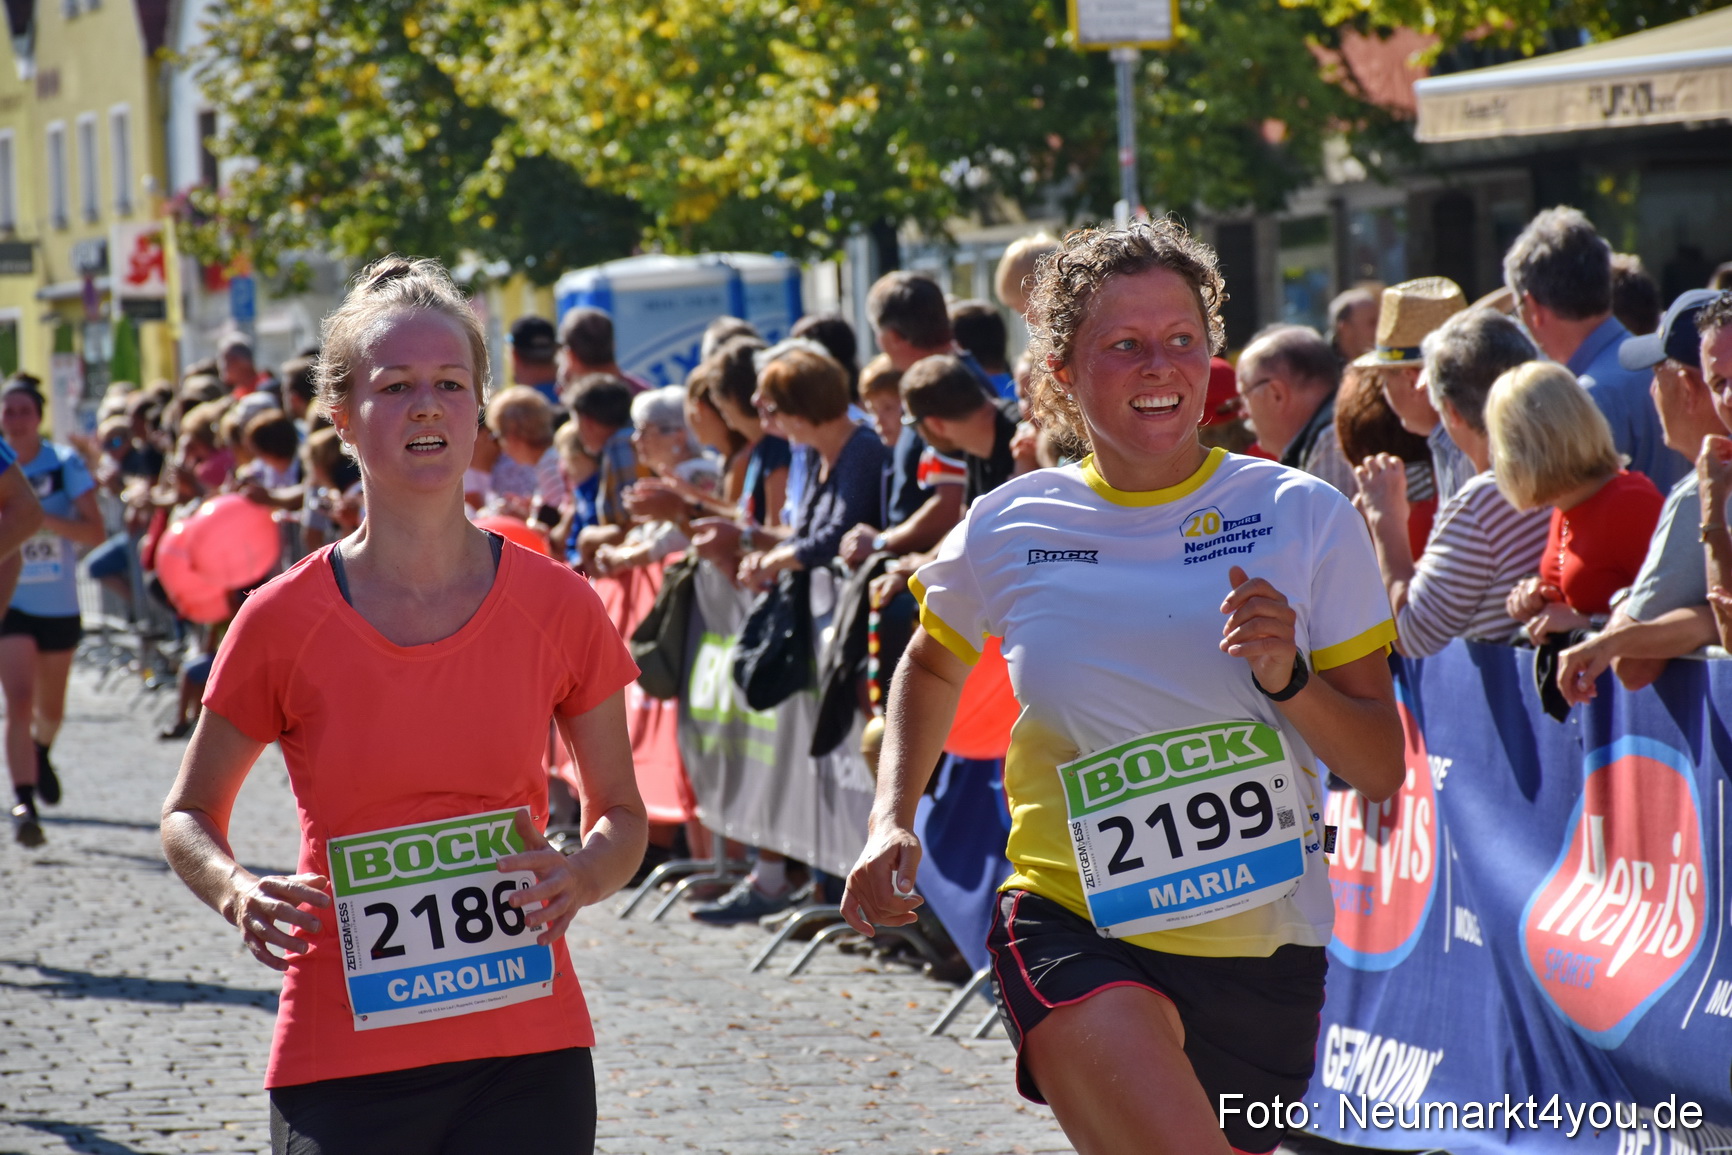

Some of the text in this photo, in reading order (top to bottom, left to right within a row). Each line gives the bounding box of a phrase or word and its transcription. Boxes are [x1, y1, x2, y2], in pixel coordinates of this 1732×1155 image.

[1183, 526, 1274, 554] Neumarkter
[1185, 512, 1260, 537] 20 JAHRE
[1028, 549, 1099, 562] BOCK
[1183, 542, 1255, 565] Stadtlauf
[1083, 727, 1257, 802] BOCK
[1097, 778, 1284, 876] 2199 D
[349, 824, 513, 882] BOCK
[1148, 863, 1255, 909] MARIA
[1537, 811, 1697, 978] Hervis
[363, 880, 526, 960] 2186
[387, 957, 526, 1002] CAROLIN
[1544, 947, 1602, 989] SPORTS
